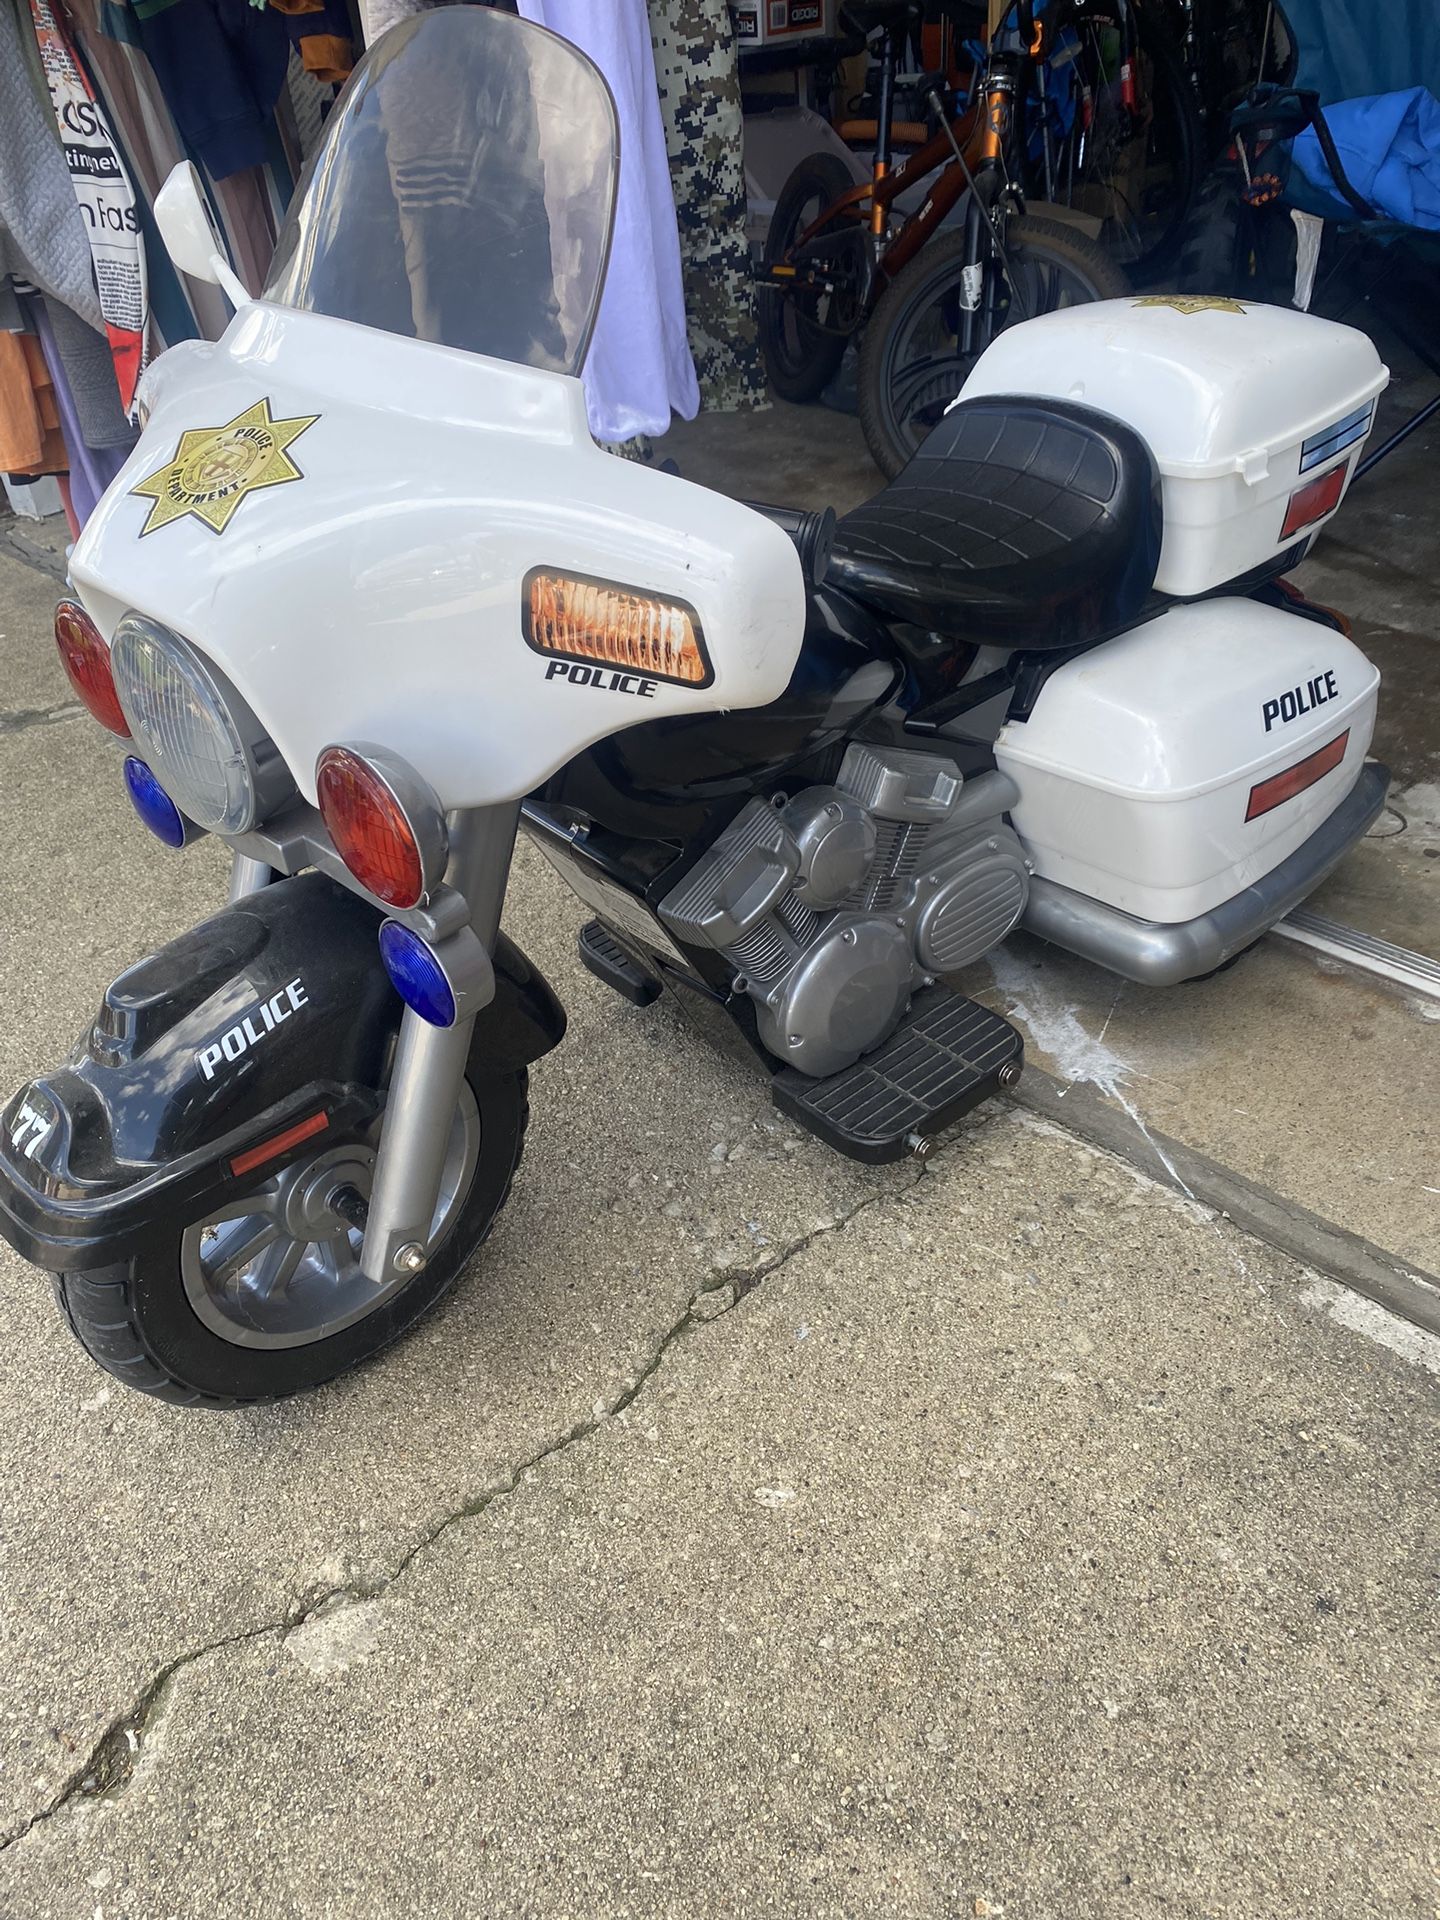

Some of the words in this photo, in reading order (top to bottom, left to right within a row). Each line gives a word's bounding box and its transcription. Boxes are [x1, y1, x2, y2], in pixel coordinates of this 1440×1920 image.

[234, 427, 273, 451] POLICE
[167, 467, 240, 504] DEPARTMENT
[544, 660, 659, 698] POLICE
[1262, 670, 1339, 732] POLICE
[198, 977, 309, 1081] POLICE
[11, 1103, 51, 1159] 77
